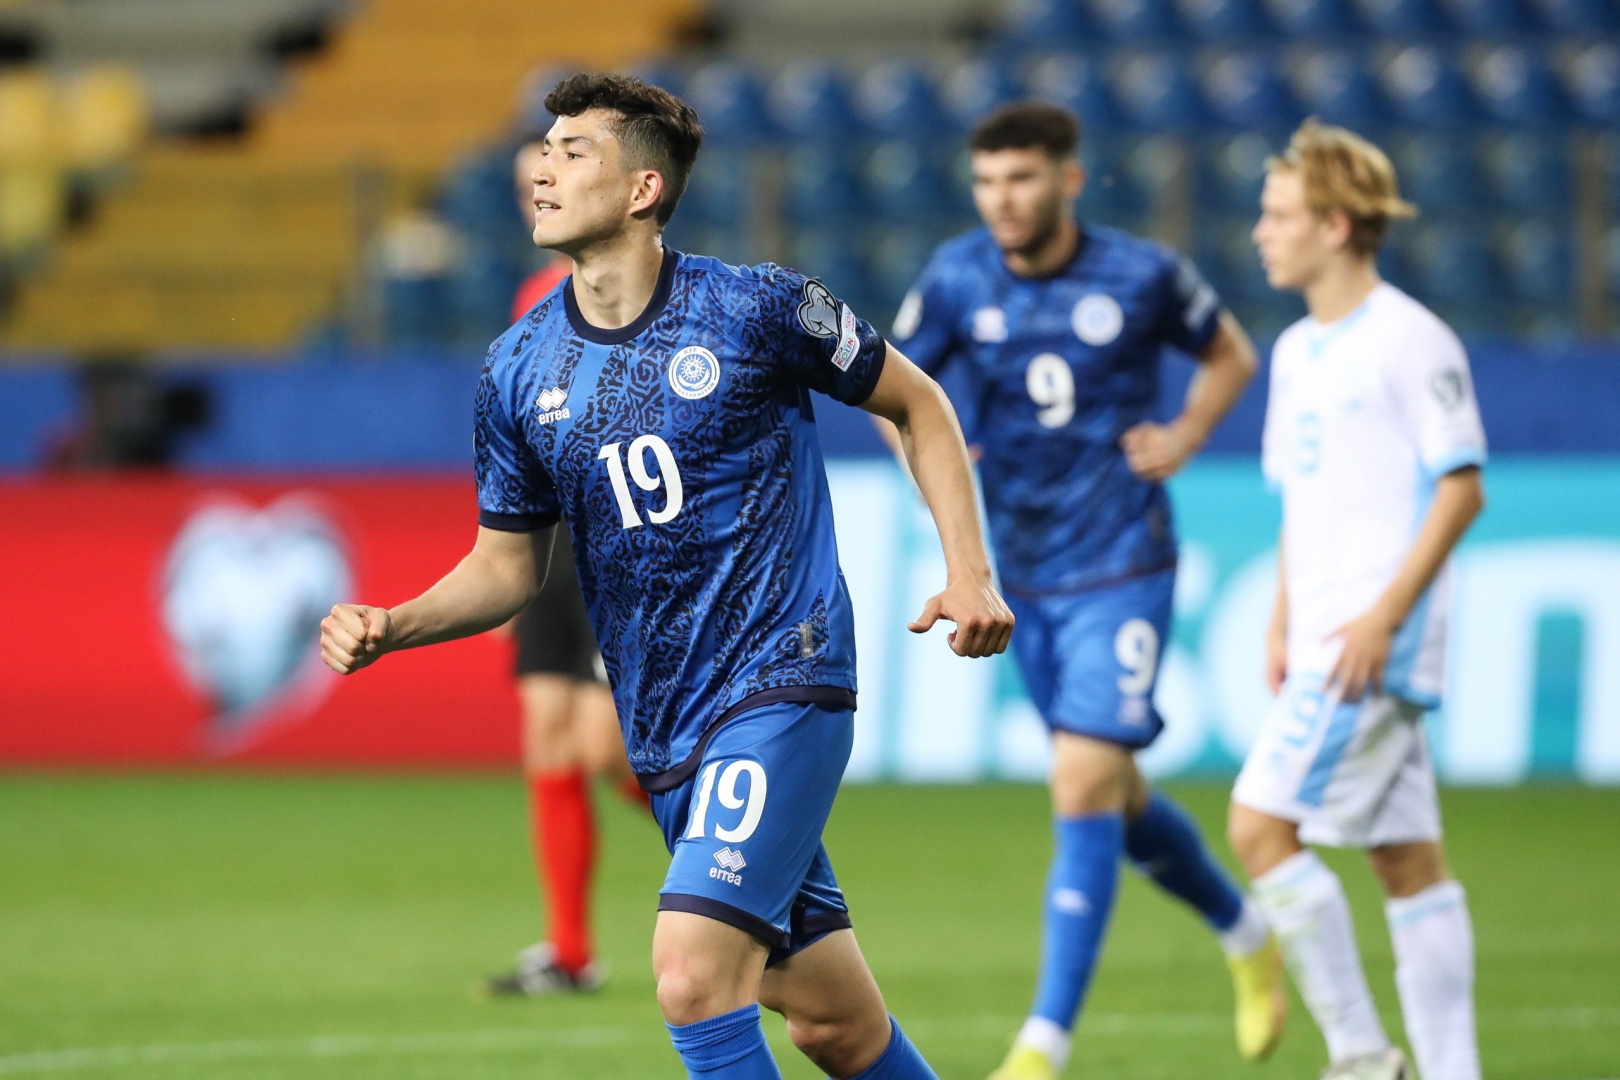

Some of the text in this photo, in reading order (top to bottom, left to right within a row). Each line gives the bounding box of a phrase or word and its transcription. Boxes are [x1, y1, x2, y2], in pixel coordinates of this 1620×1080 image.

[683, 347, 698, 355] KFF
[677, 382, 715, 398] KAZAKHSTAN
[1025, 352, 1076, 429] 9
[538, 407, 571, 425] errea
[597, 434, 684, 530] 19
[1113, 617, 1160, 696] 9
[686, 759, 768, 843] 19
[709, 866, 743, 887] errea
